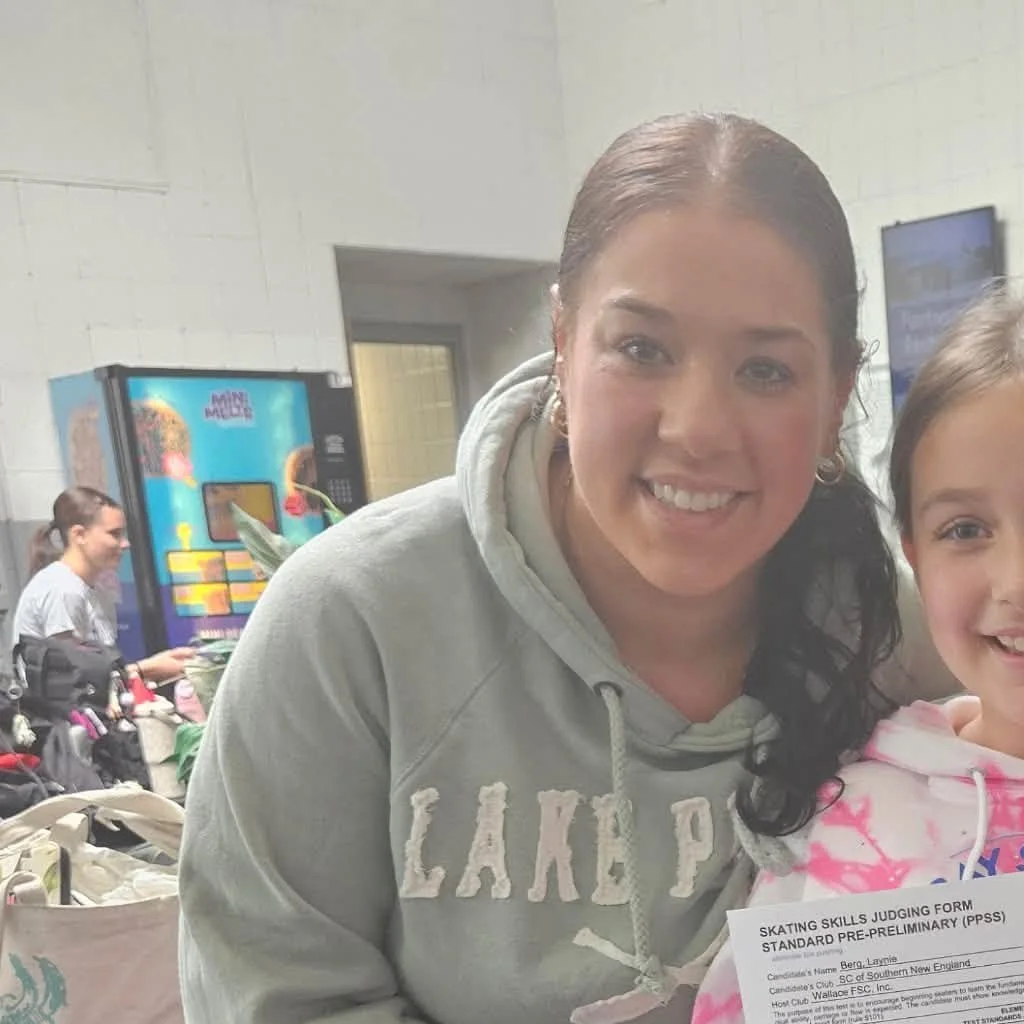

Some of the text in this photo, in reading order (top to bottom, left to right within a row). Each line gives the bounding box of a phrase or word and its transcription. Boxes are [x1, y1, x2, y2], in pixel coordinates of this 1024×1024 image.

[758, 899, 973, 937] SKATING SKILLS JUDGING FORM
[761, 910, 1006, 952] STANDARD PRE-PRELIMINARY (PPSS)
[767, 969, 812, 980] Candidate's
[813, 966, 837, 975] Name
[769, 958, 970, 995] Candidate's Club SC of Southern New England
[771, 1000, 789, 1008] Host
[790, 997, 808, 1006] Club
[811, 988, 849, 1000] Wallace
[900, 991, 932, 1003] beginning
[985, 982, 995, 990] the
[906, 1000, 919, 1008] The
[954, 993, 970, 1001] must
[981, 1013, 1021, 1024] STANDARDS
